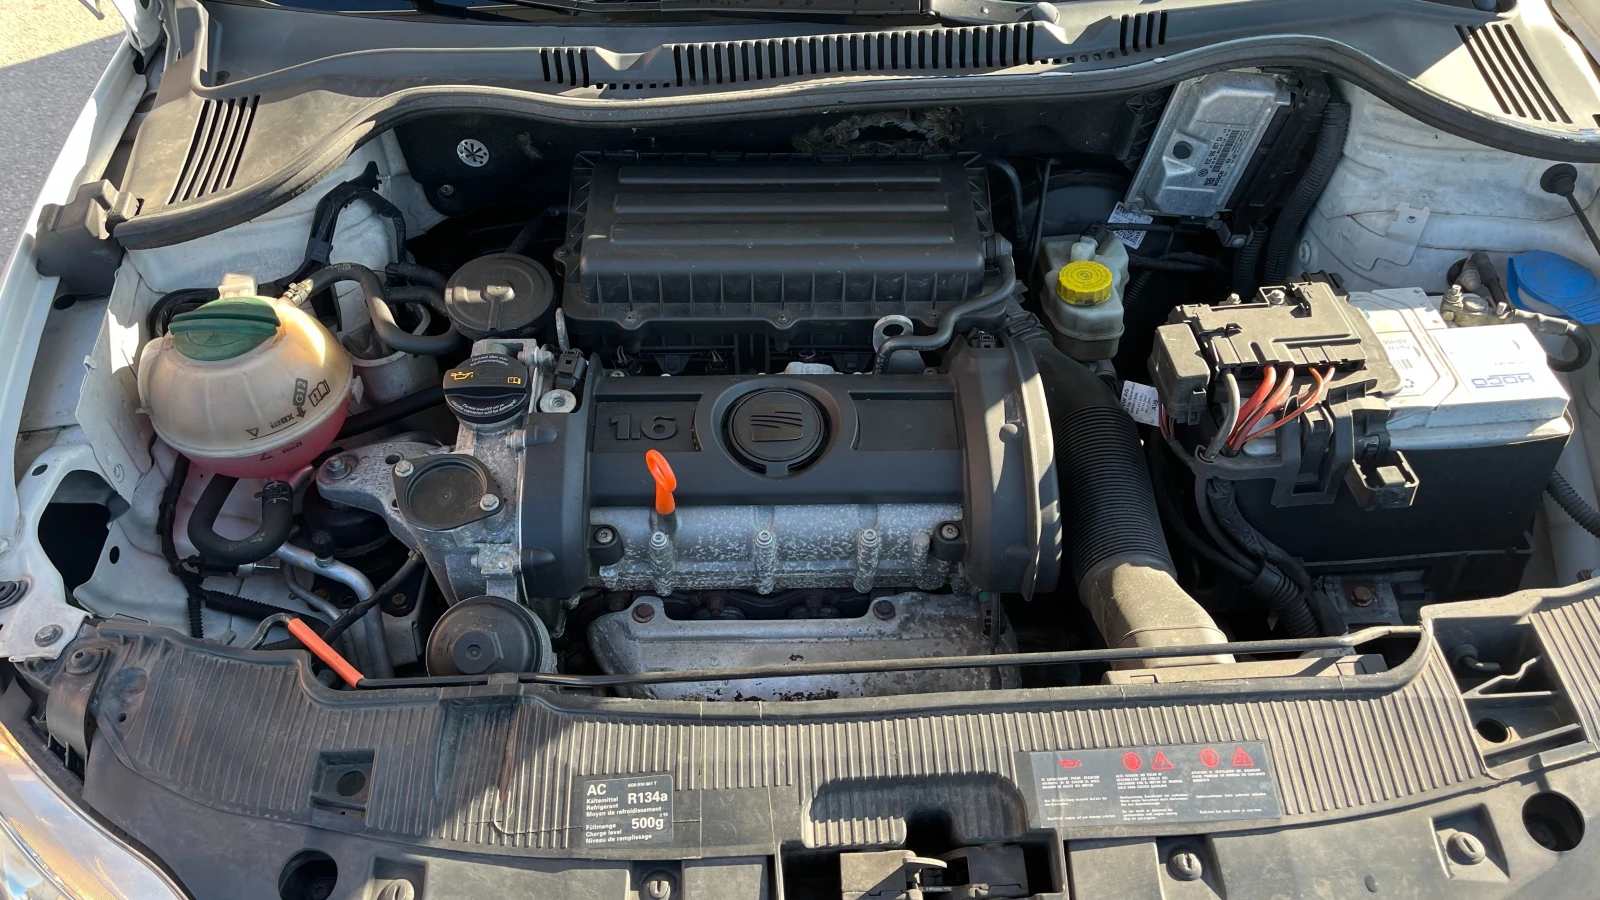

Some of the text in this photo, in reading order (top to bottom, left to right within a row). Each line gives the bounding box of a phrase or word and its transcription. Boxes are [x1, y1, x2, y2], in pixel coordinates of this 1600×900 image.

[295, 381, 306, 403] G12
[610, 413, 677, 440] 1.6
[587, 784, 606, 796] AC
[628, 791, 668, 804] R134a
[617, 807, 662, 815] refroidissement
[632, 817, 664, 830] 500g
